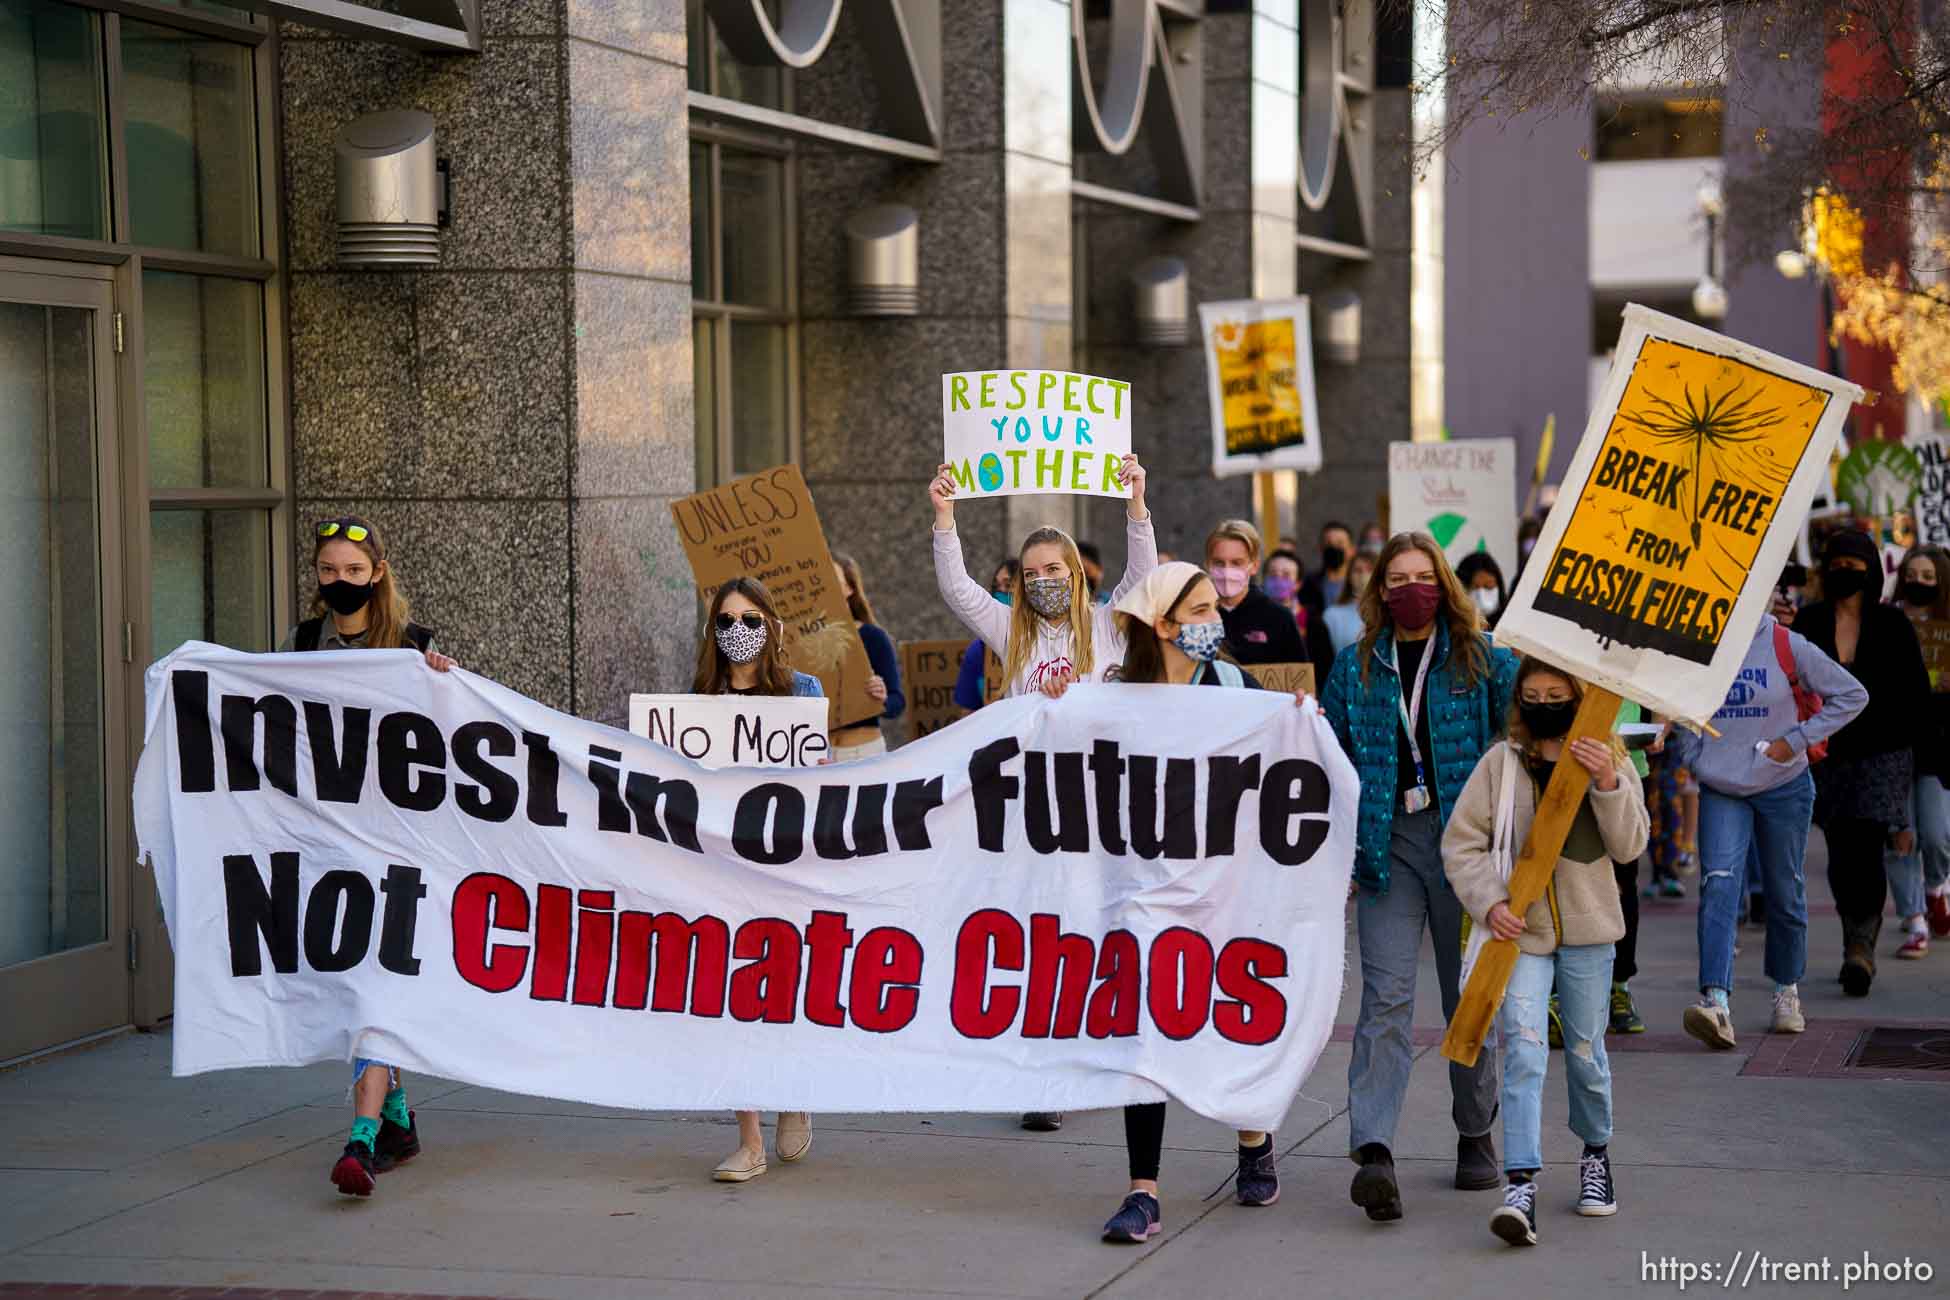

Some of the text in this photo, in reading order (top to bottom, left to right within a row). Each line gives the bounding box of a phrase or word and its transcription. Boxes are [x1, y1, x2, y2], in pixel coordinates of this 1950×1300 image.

[951, 371, 1129, 420] RESPECT
[990, 415, 1093, 445] YOUR
[950, 448, 1125, 492] MOTHER
[1595, 446, 1773, 536] BREAK FREE
[676, 470, 799, 545] UNLESS
[734, 544, 771, 571] YOU
[1625, 528, 1691, 571] FROM
[1736, 668, 1768, 689] ON
[648, 706, 828, 768] No More
[172, 669, 567, 828] Invest
[588, 743, 704, 855] in
[732, 775, 944, 865] our
[223, 851, 1289, 1045] Not Climate Chaos
